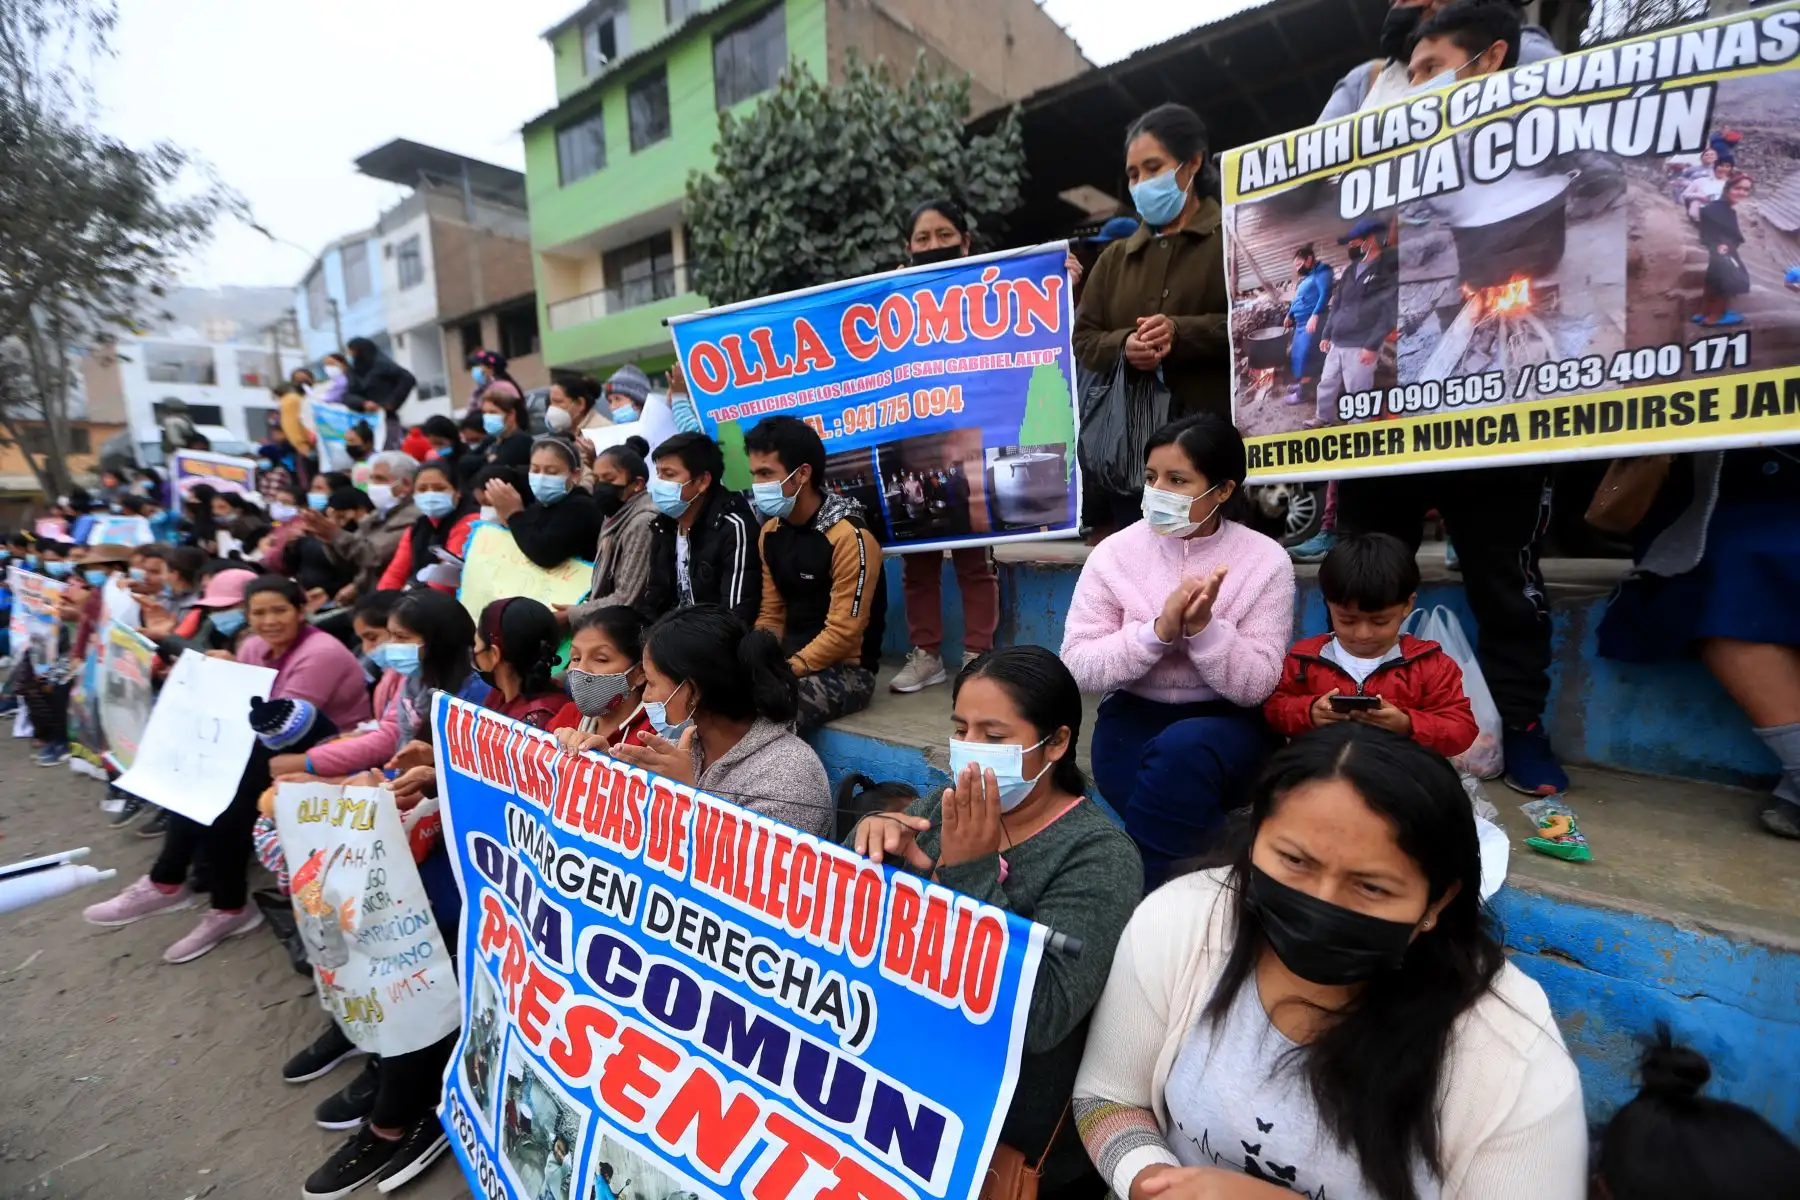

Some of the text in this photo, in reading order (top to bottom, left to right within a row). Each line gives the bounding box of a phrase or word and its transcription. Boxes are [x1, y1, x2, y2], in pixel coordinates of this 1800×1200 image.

[1361, 98, 1442, 157] LAS
[1450, 10, 1800, 122] CASUARINAS
[1340, 84, 1712, 219] OLLA COMÚN
[688, 267, 1063, 395] OLLA COMÚN
[740, 394, 798, 416] DELICIAS
[798, 390, 816, 406] DE
[817, 384, 841, 402] LOS
[841, 369, 892, 395] ALAMOS
[895, 363, 911, 383] DE
[912, 360, 944, 378] SAN
[946, 352, 1013, 373] GABRIEL
[1339, 391, 1382, 420] 997
[1388, 383, 1440, 414] 090
[1446, 376, 1502, 408] 505
[1538, 355, 1603, 394] 933
[1609, 346, 1682, 381] 400
[1689, 334, 1748, 370] 171
[843, 404, 876, 435] 941
[877, 392, 911, 427] 775
[913, 385, 964, 419] 094
[1247, 428, 1405, 469] RETROCEDER
[1413, 413, 1519, 452] NUNCA
[1529, 388, 1719, 442] RENDIRSE
[446, 704, 1004, 1014] AA HH LAS VEGAS DE VALLECITO BAJO
[507, 808, 872, 1049] (MARGEN DERECHA)
[586, 932, 946, 1182] COMUN
